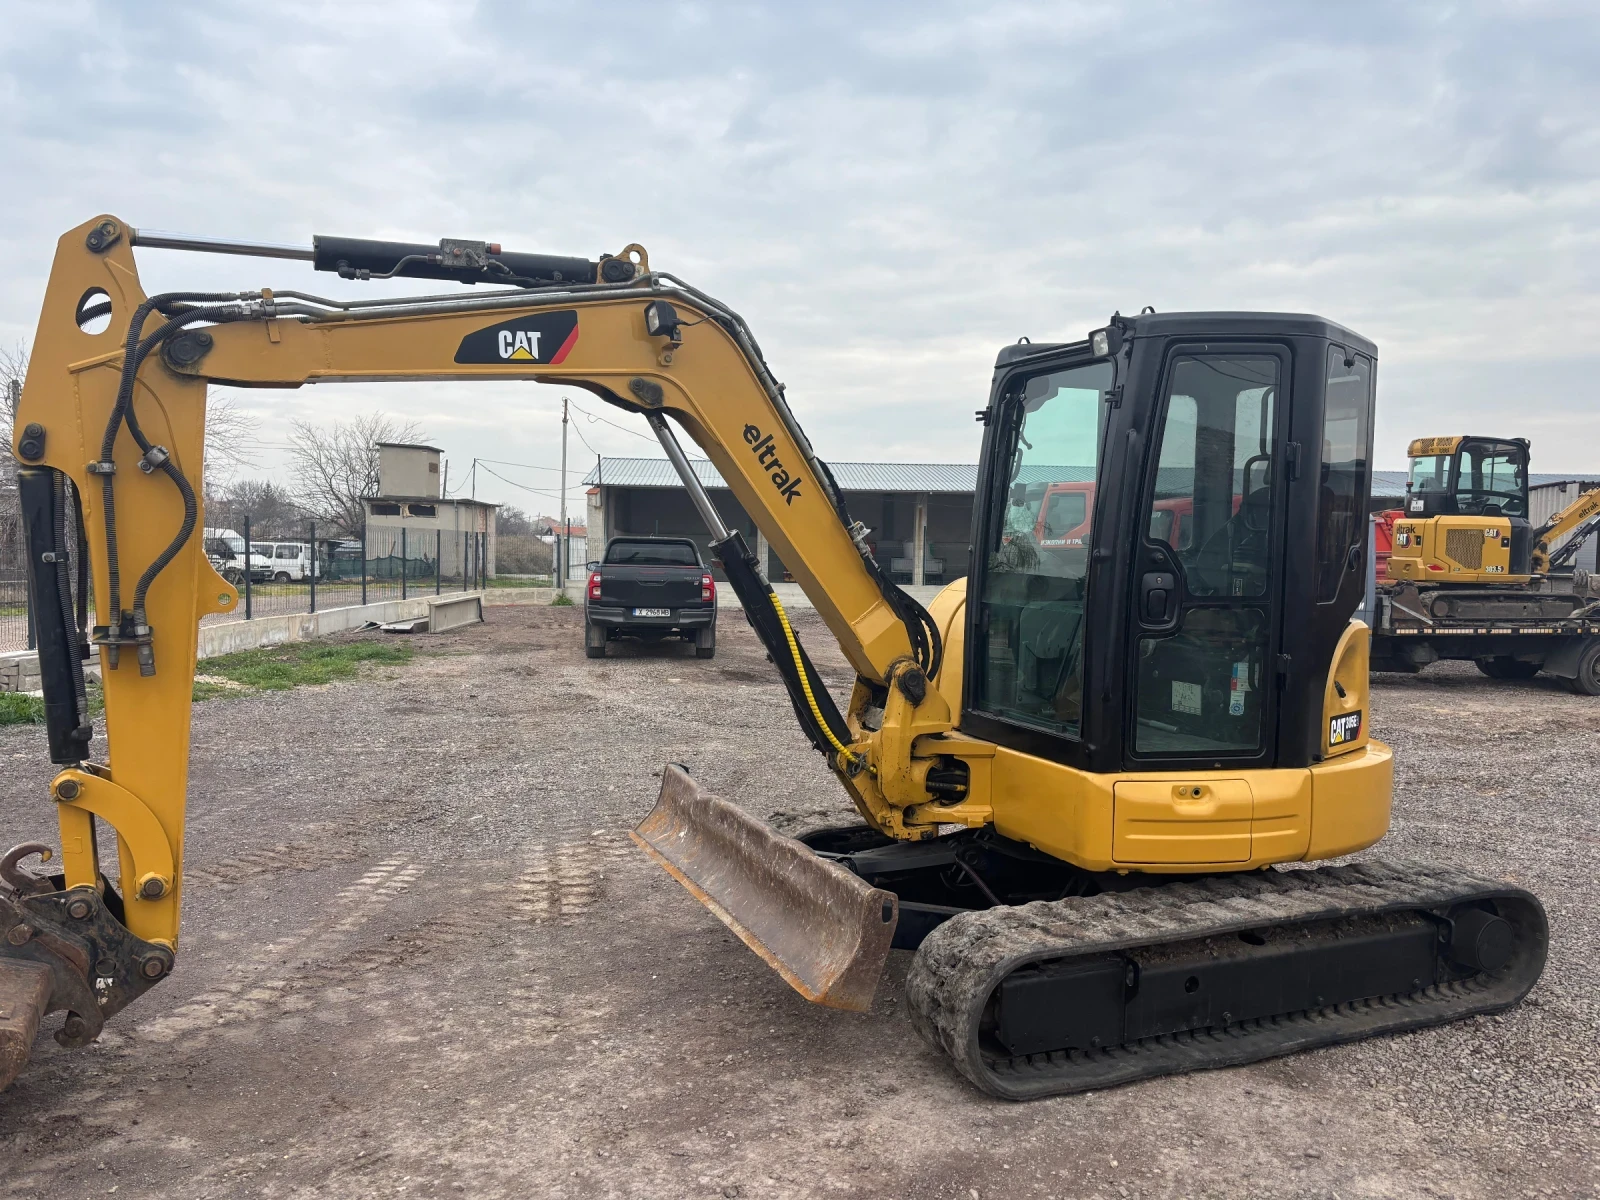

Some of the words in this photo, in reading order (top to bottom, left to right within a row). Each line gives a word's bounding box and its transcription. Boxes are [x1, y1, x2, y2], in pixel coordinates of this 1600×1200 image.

[498, 330, 541, 359] CAT
[743, 423, 802, 506] eltrak
[1579, 501, 1599, 518] eltrak
[1485, 528, 1498, 537] CAT
[1330, 718, 1345, 743] CAT
